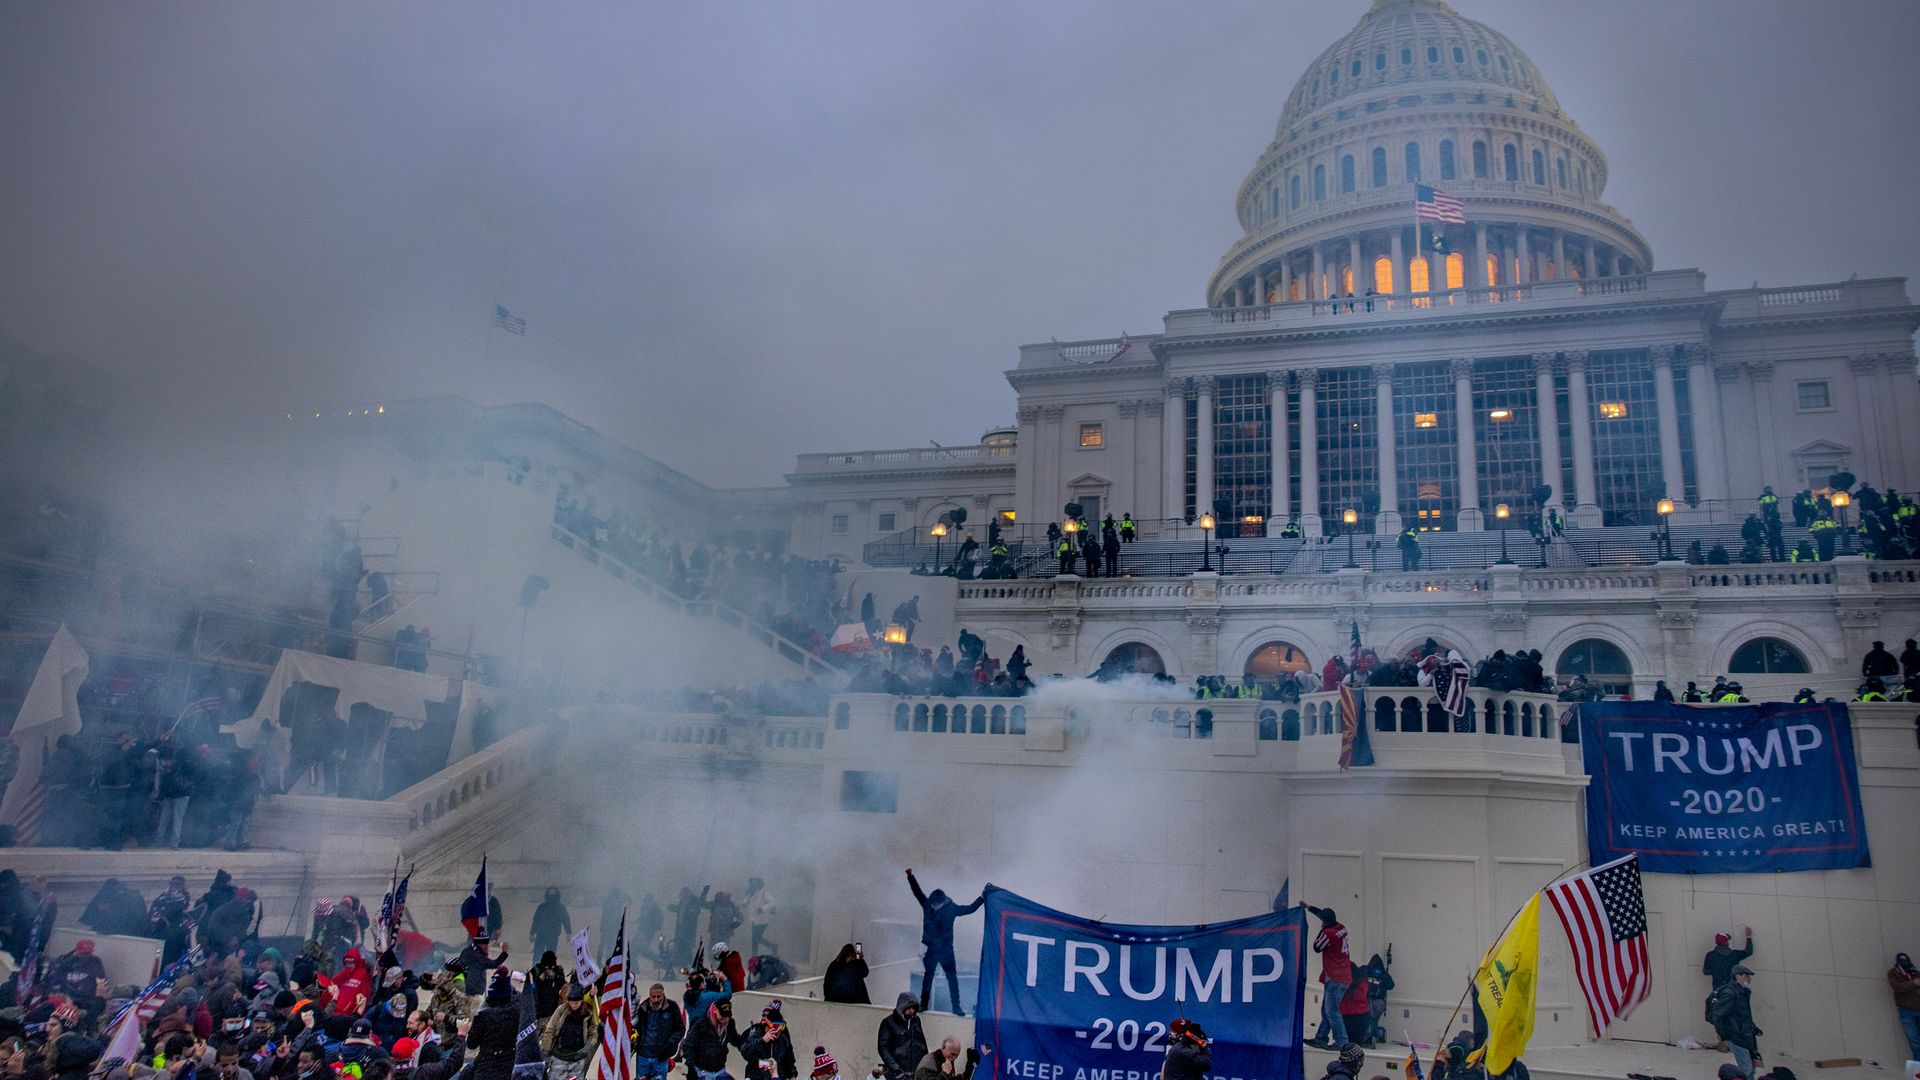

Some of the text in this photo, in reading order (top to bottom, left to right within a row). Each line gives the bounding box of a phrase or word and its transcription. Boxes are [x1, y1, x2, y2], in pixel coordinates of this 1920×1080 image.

[1608, 724, 1823, 776] TRUMP
[1620, 820, 1846, 840] KEEP AMERICA GREAT!
[1012, 932, 1284, 1004] TRUMP
[1006, 1058, 1064, 1080] KEEP
